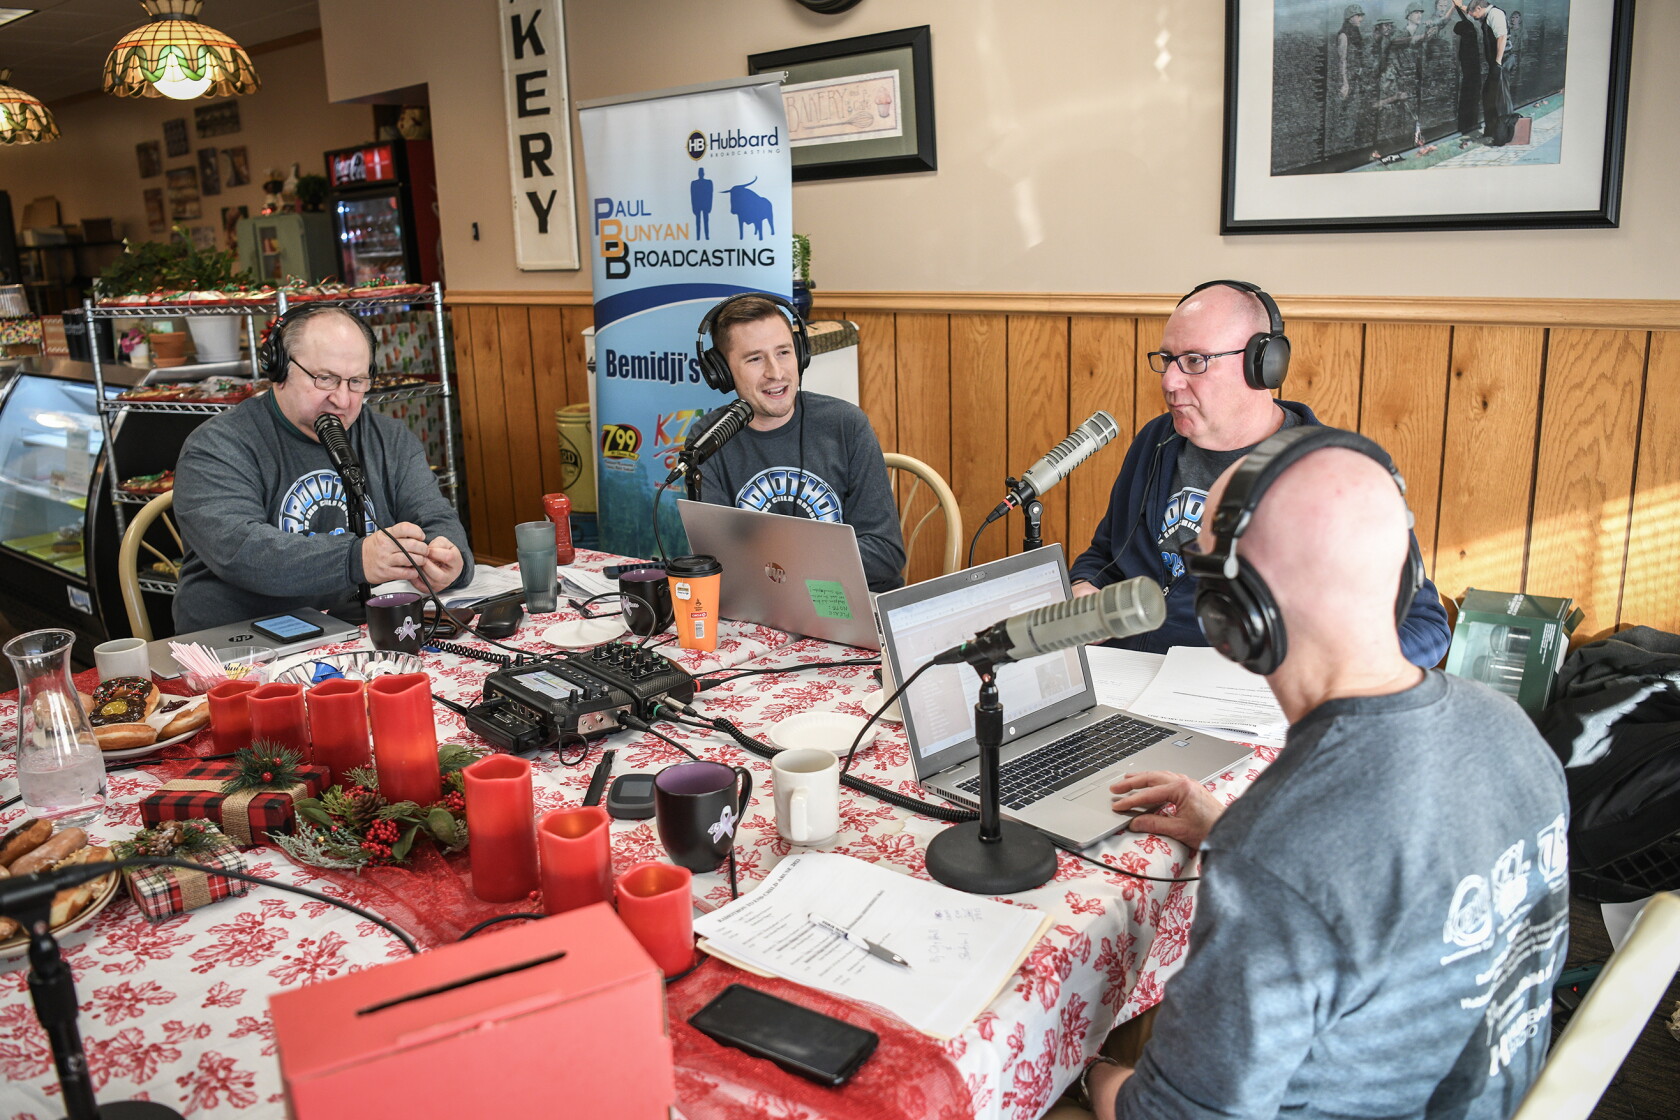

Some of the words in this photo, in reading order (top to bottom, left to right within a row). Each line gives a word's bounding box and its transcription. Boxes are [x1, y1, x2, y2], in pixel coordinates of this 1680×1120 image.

[509, 0, 558, 234] KERY
[688, 137, 704, 152] HB
[709, 126, 779, 150] Hubbard
[710, 148, 781, 158] BROADCASTING
[594, 197, 652, 236] PAUL
[600, 218, 689, 258] BUNYAN
[605, 241, 775, 280] BROADCASTING
[605, 348, 700, 385] Bemidji's
[602, 424, 637, 458] Z99
[654, 407, 712, 447] KZ
[738, 470, 840, 523] DIOTHO
